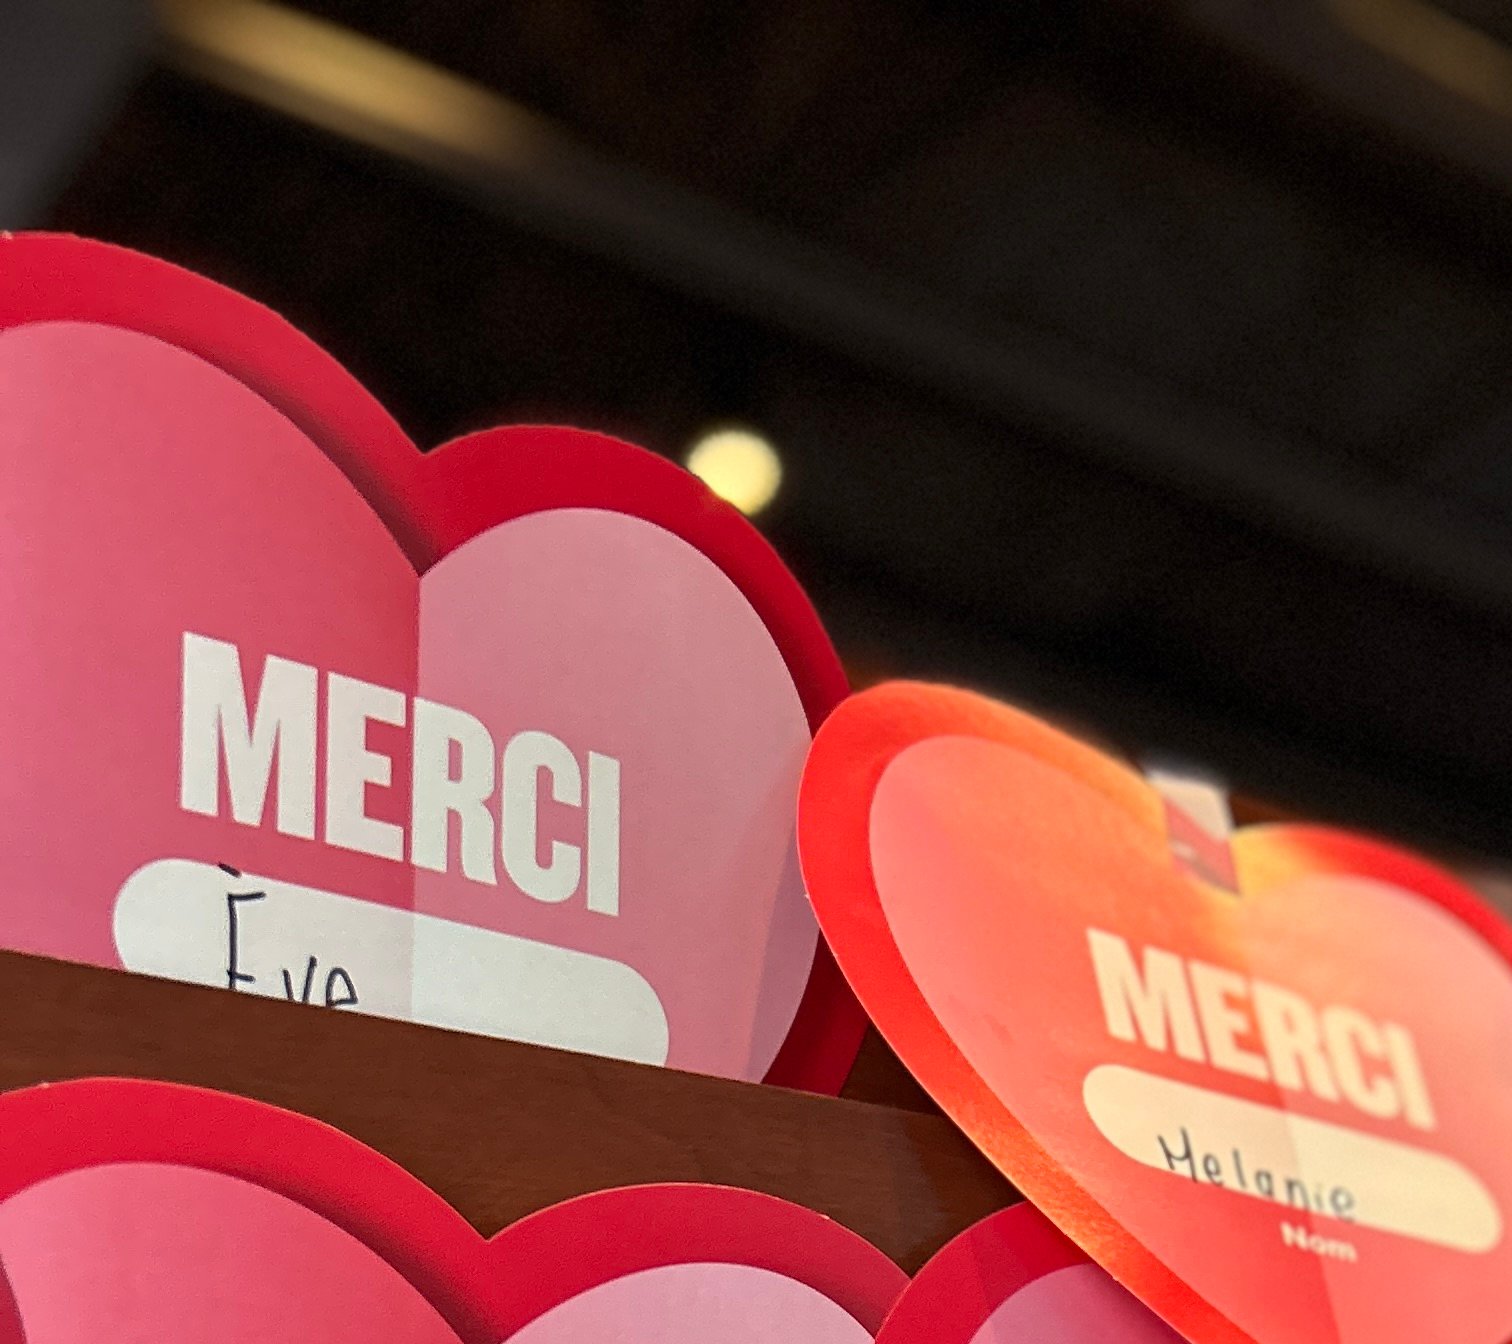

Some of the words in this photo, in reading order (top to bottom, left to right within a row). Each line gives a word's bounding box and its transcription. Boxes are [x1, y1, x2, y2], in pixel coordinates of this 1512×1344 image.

[180, 631, 621, 917] MERCI
[1086, 926, 1437, 1132] MERCI
[1280, 1222, 1358, 1263] Nom
